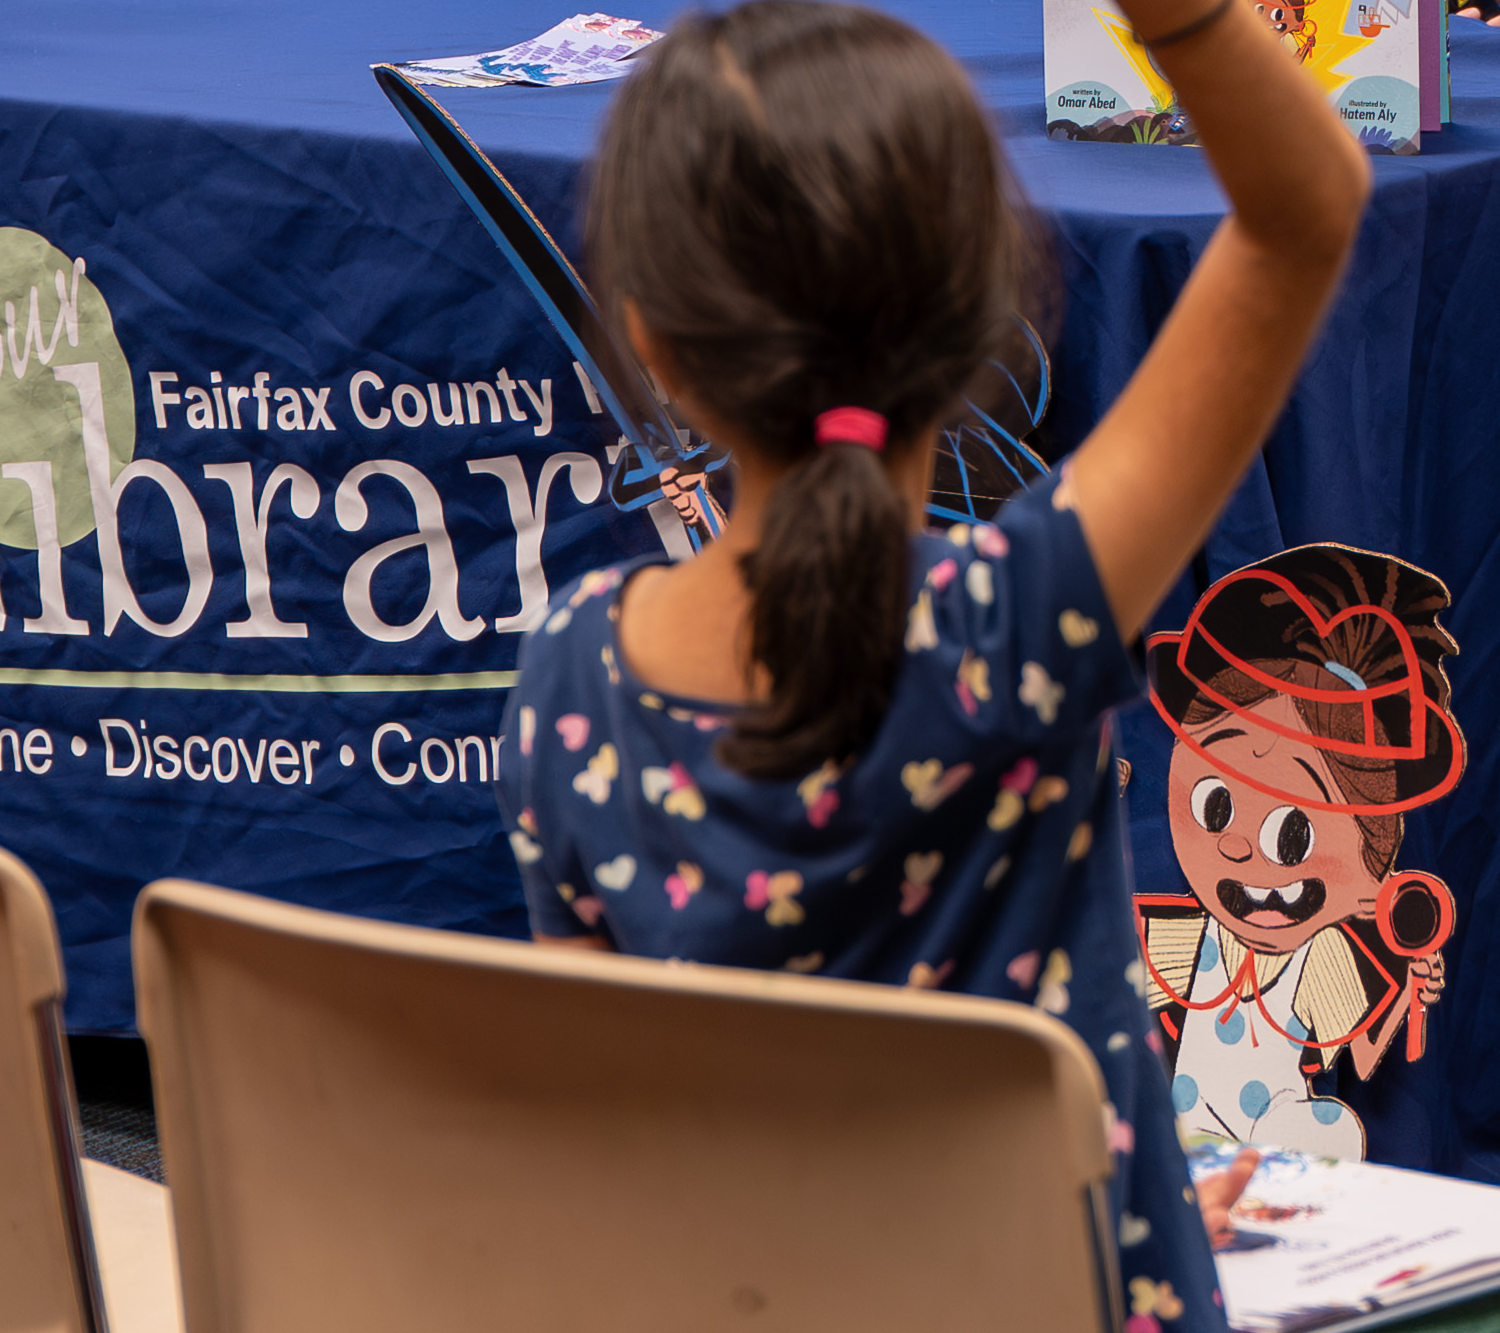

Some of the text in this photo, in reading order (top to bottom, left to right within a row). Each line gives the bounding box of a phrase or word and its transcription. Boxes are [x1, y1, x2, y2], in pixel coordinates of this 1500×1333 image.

[1057, 95, 1117, 110] Omar Abed
[1340, 107, 1397, 123] Hatem Aly
[149, 370, 336, 432] Fairfax
[349, 367, 553, 437] County
[104, 716, 321, 785] Discover
